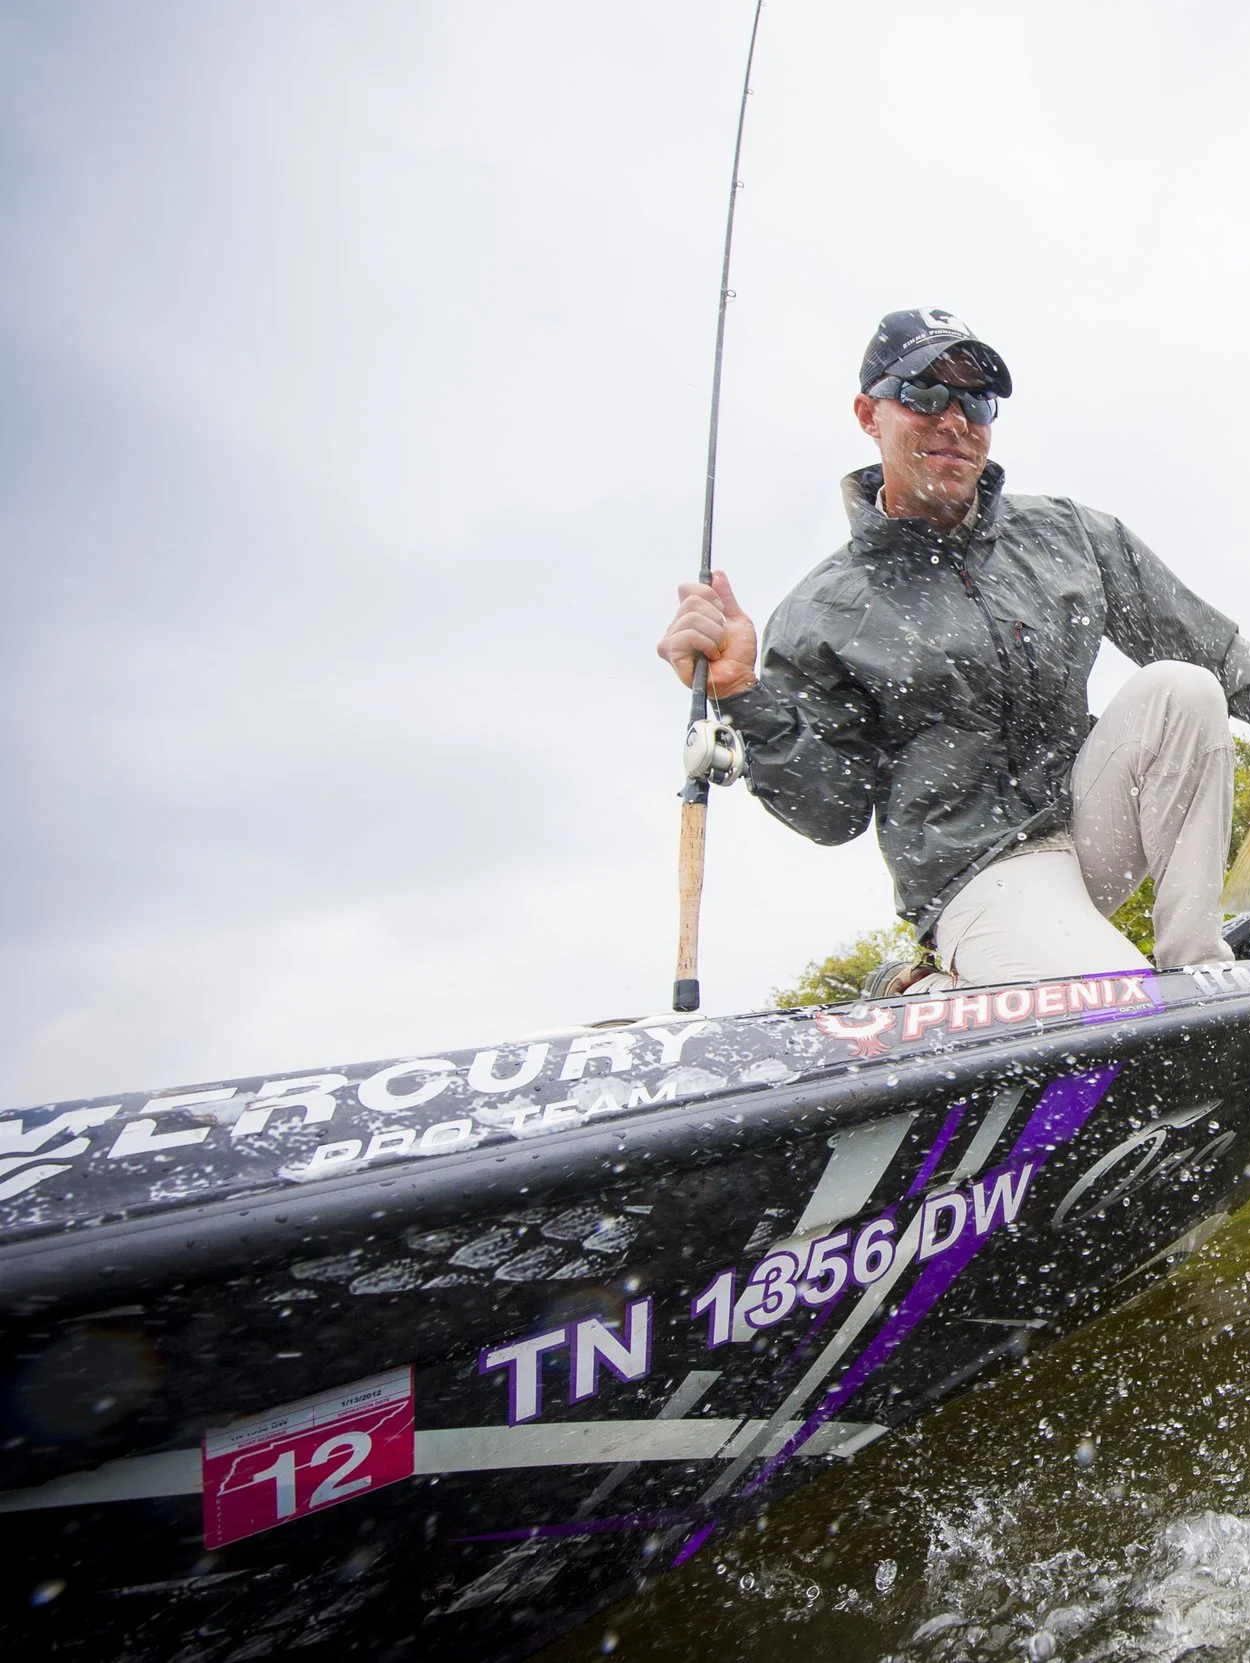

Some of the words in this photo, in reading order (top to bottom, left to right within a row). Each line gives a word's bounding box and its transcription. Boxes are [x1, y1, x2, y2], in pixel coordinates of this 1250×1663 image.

[902, 974, 1151, 1040] PHOENIX
[308, 1119, 474, 1170] PRO
[502, 1082, 678, 1132] TEAM
[478, 1295, 653, 1427] TN
[692, 1214, 898, 1350] 1356
[916, 1164, 1034, 1264] DW
[253, 1431, 372, 1520] 12
